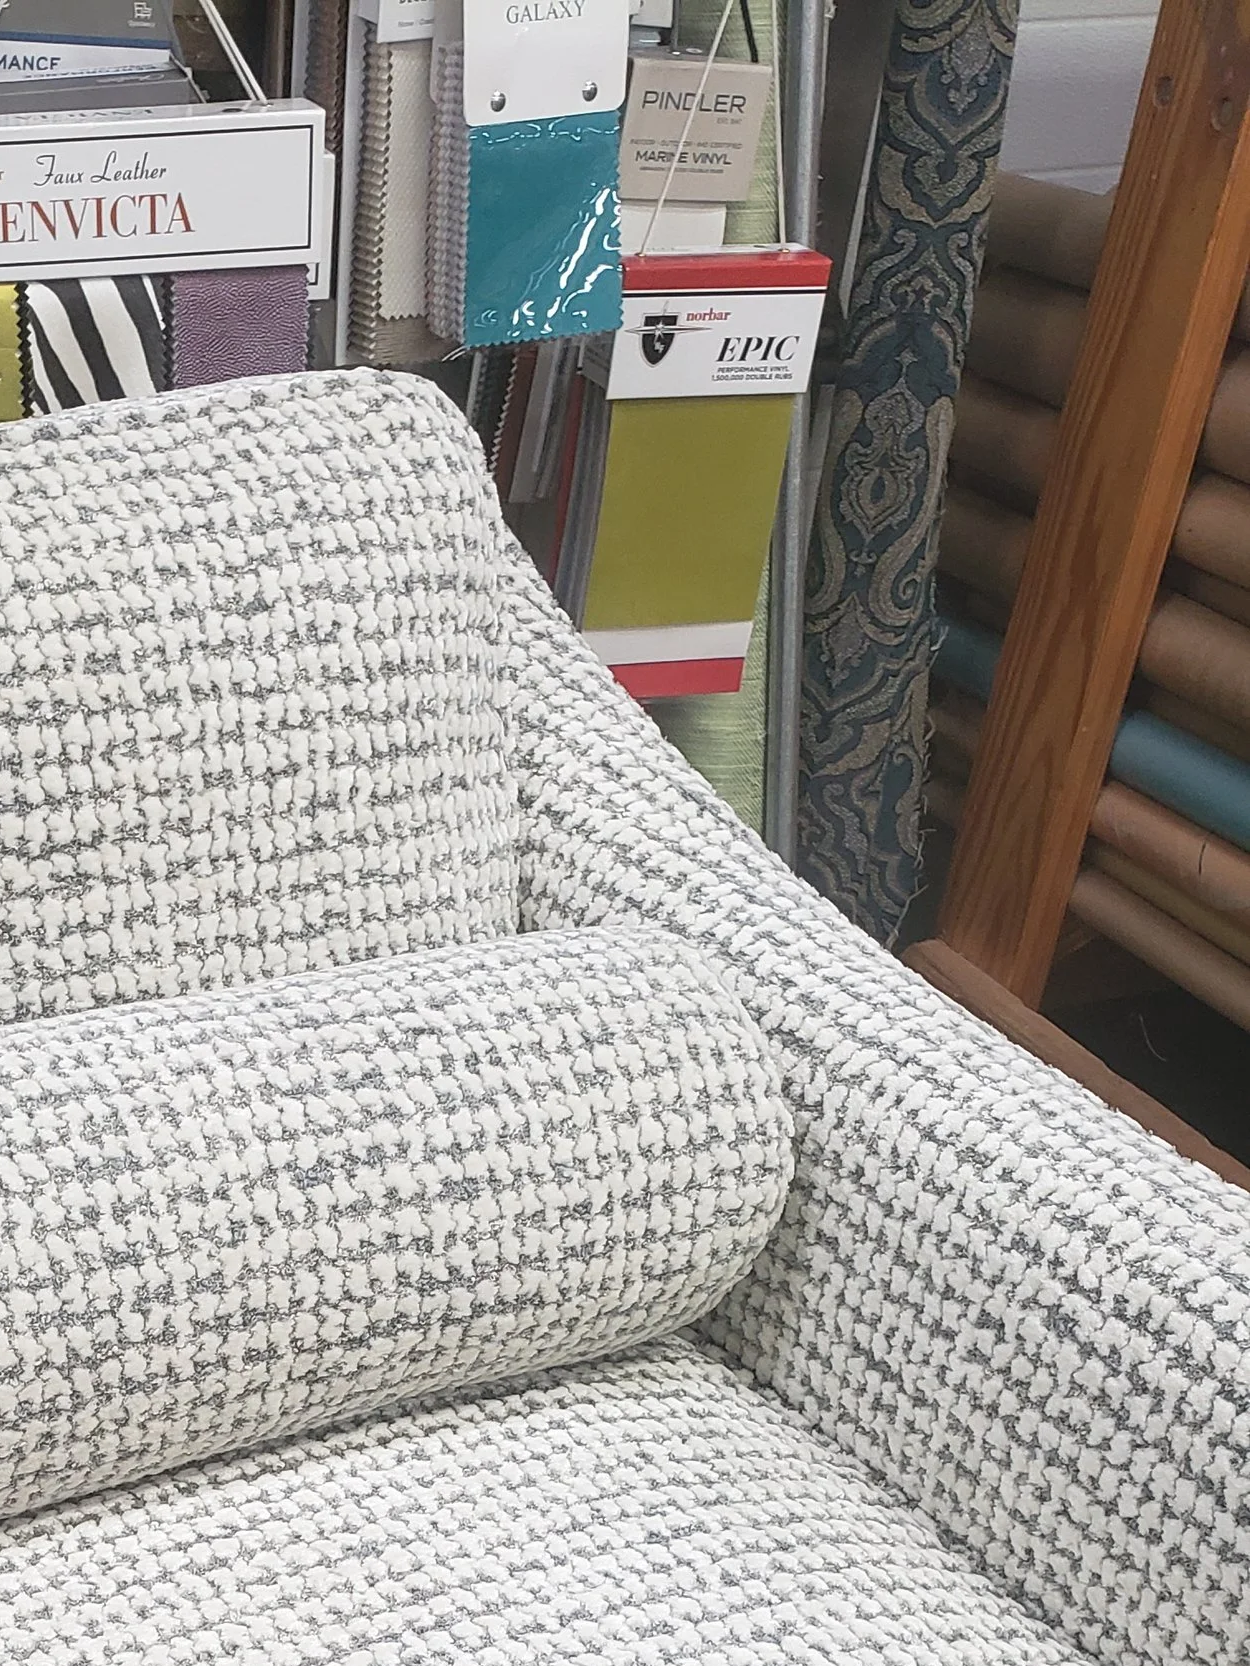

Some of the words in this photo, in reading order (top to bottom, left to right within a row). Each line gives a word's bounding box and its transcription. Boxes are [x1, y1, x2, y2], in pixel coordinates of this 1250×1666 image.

[506, 0, 584, 24] GALAXY
[641, 90, 747, 114] PINDLER
[33, 154, 84, 187] Faux
[91, 150, 167, 183] Leather
[692, 152, 732, 165] VINYL
[685, 307, 732, 322] norbar
[715, 335, 801, 363] EPIC
